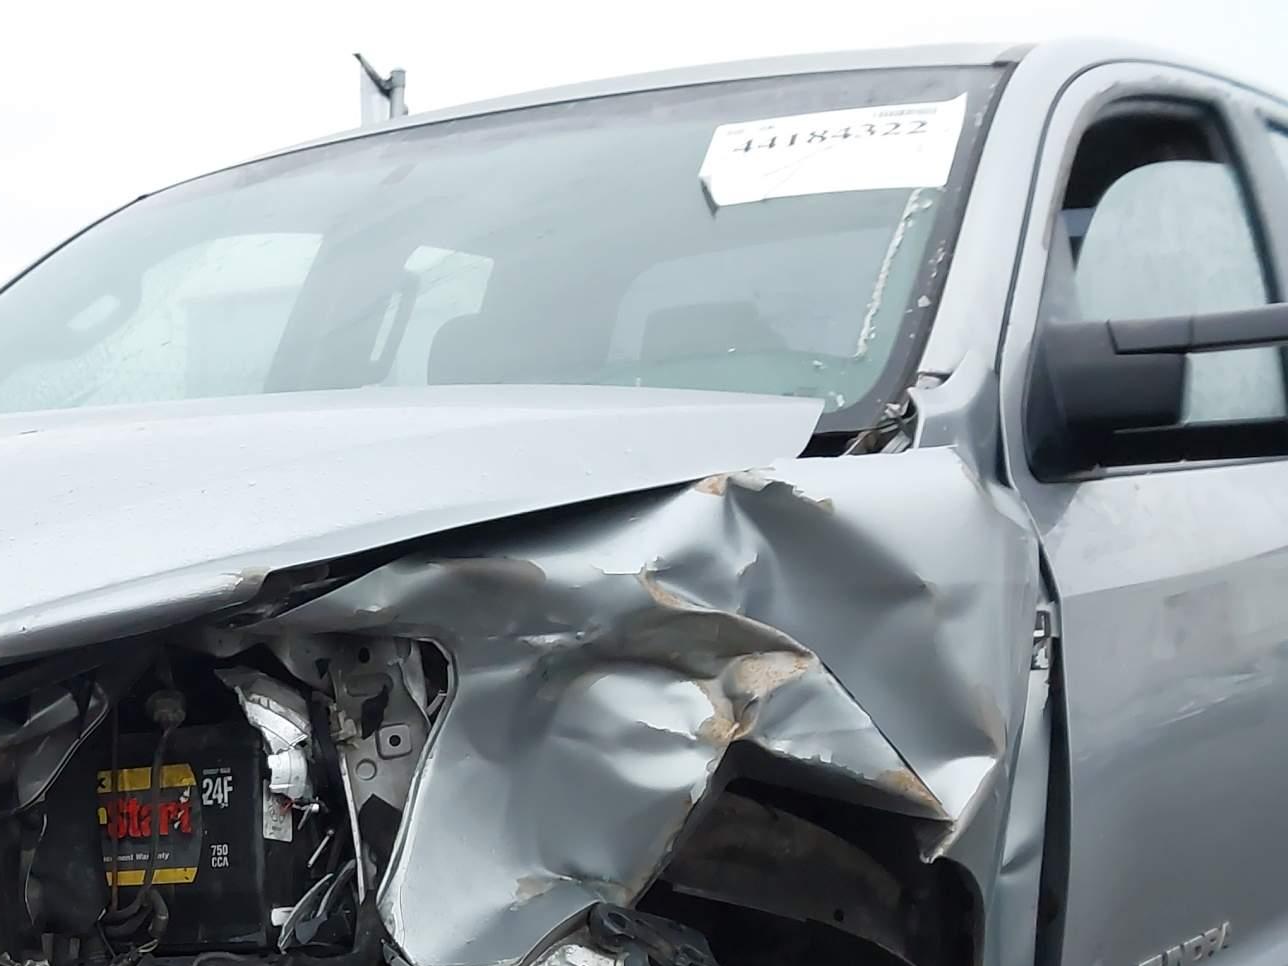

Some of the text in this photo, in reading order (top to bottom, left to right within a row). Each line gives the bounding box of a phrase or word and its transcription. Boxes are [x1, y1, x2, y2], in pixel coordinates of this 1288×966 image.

[732, 120, 928, 153] 44184322
[202, 776, 233, 805] 24F
[210, 844, 229, 856] 750
[211, 856, 229, 868] CCA
